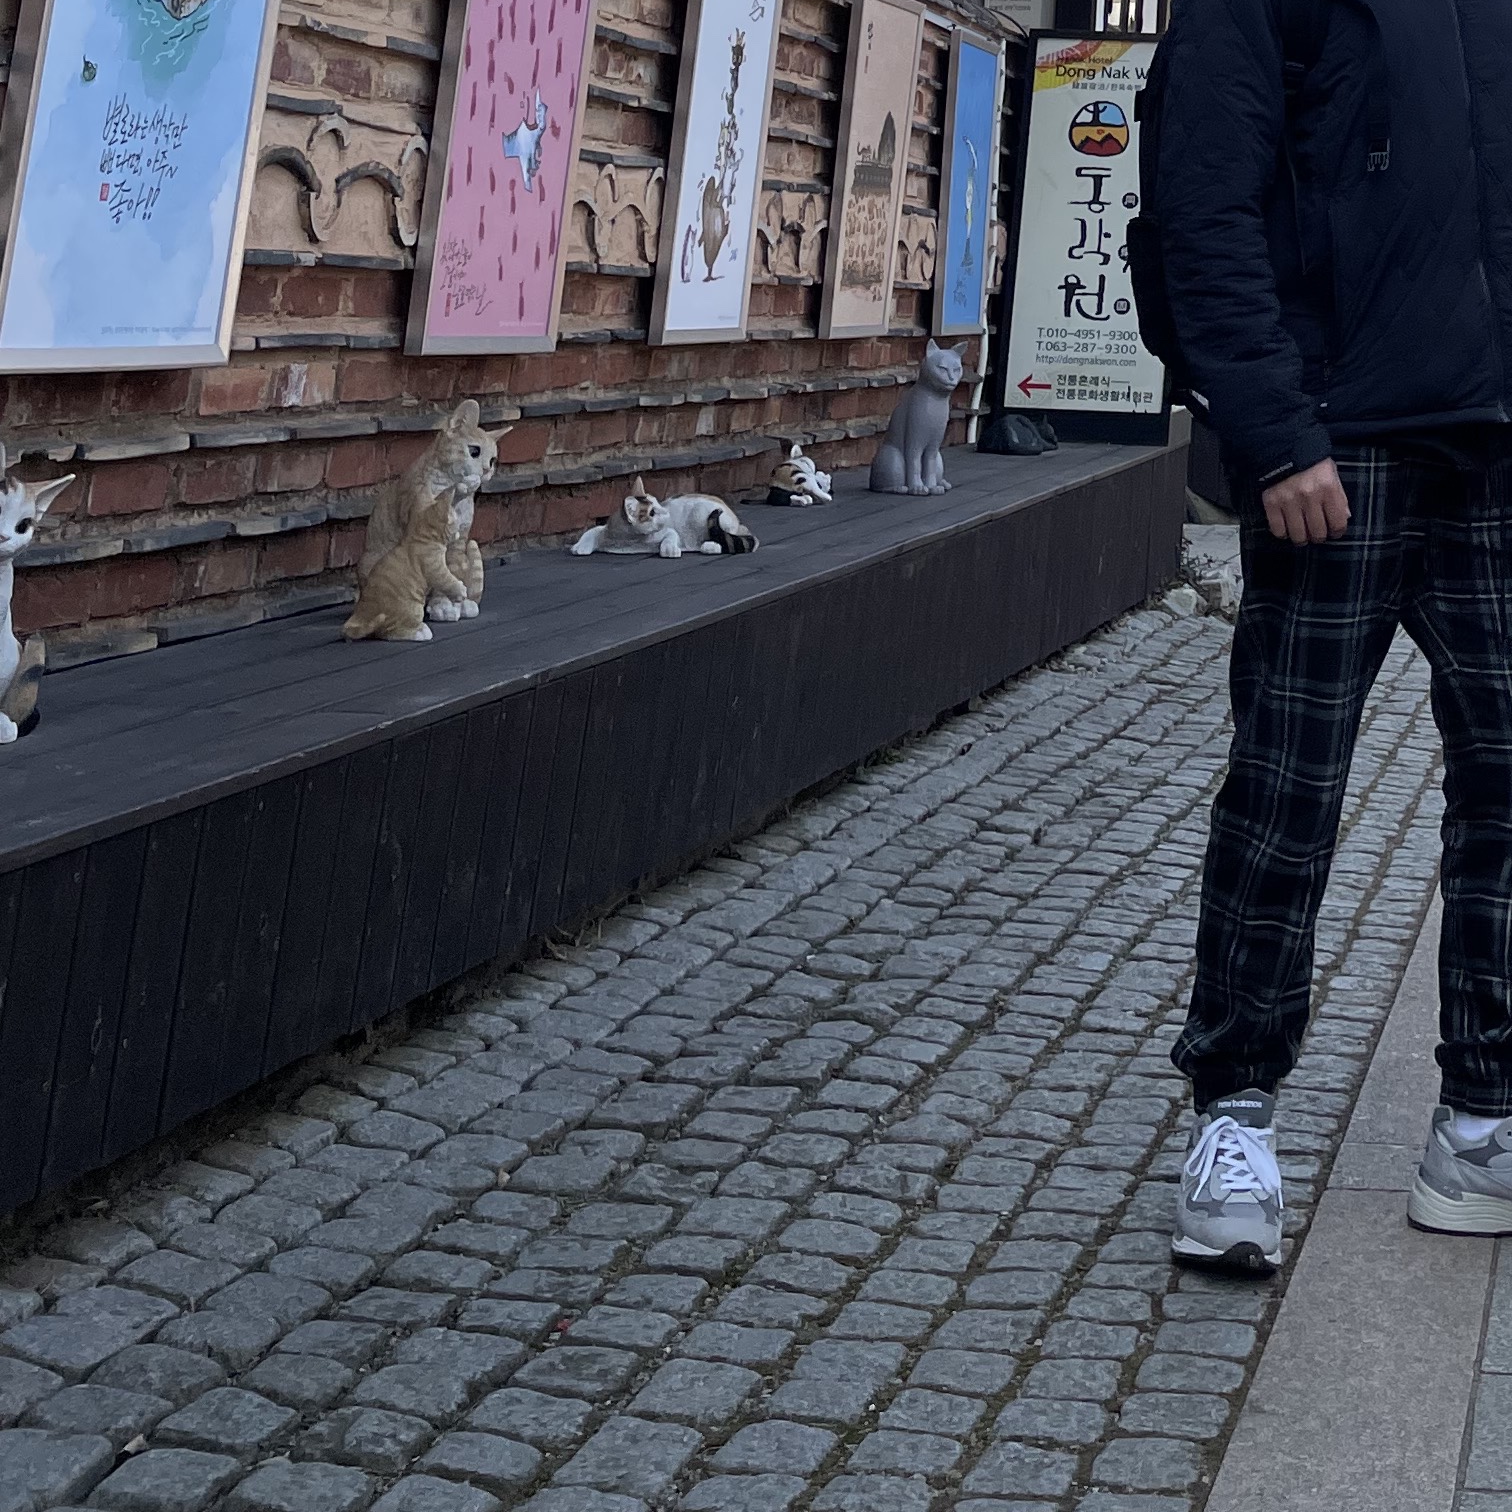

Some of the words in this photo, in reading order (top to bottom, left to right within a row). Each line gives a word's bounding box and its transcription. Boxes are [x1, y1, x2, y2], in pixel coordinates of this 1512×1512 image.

[1088, 56, 1113, 64] Hotel
[1055, 65, 1096, 80] Dong
[1101, 66, 1130, 80] Nak
[1135, 67, 1149, 80] W
[108, 178, 161, 225] 좋아!!
[1058, 166, 1113, 321] 동락원
[1036, 327, 1138, 342] T.010-4951-9300
[1035, 340, 1138, 355] T.063-287-9300
[1035, 354, 1137, 367] http://dongnakwon.com
[1056, 374, 1111, 387] 전통혼례식
